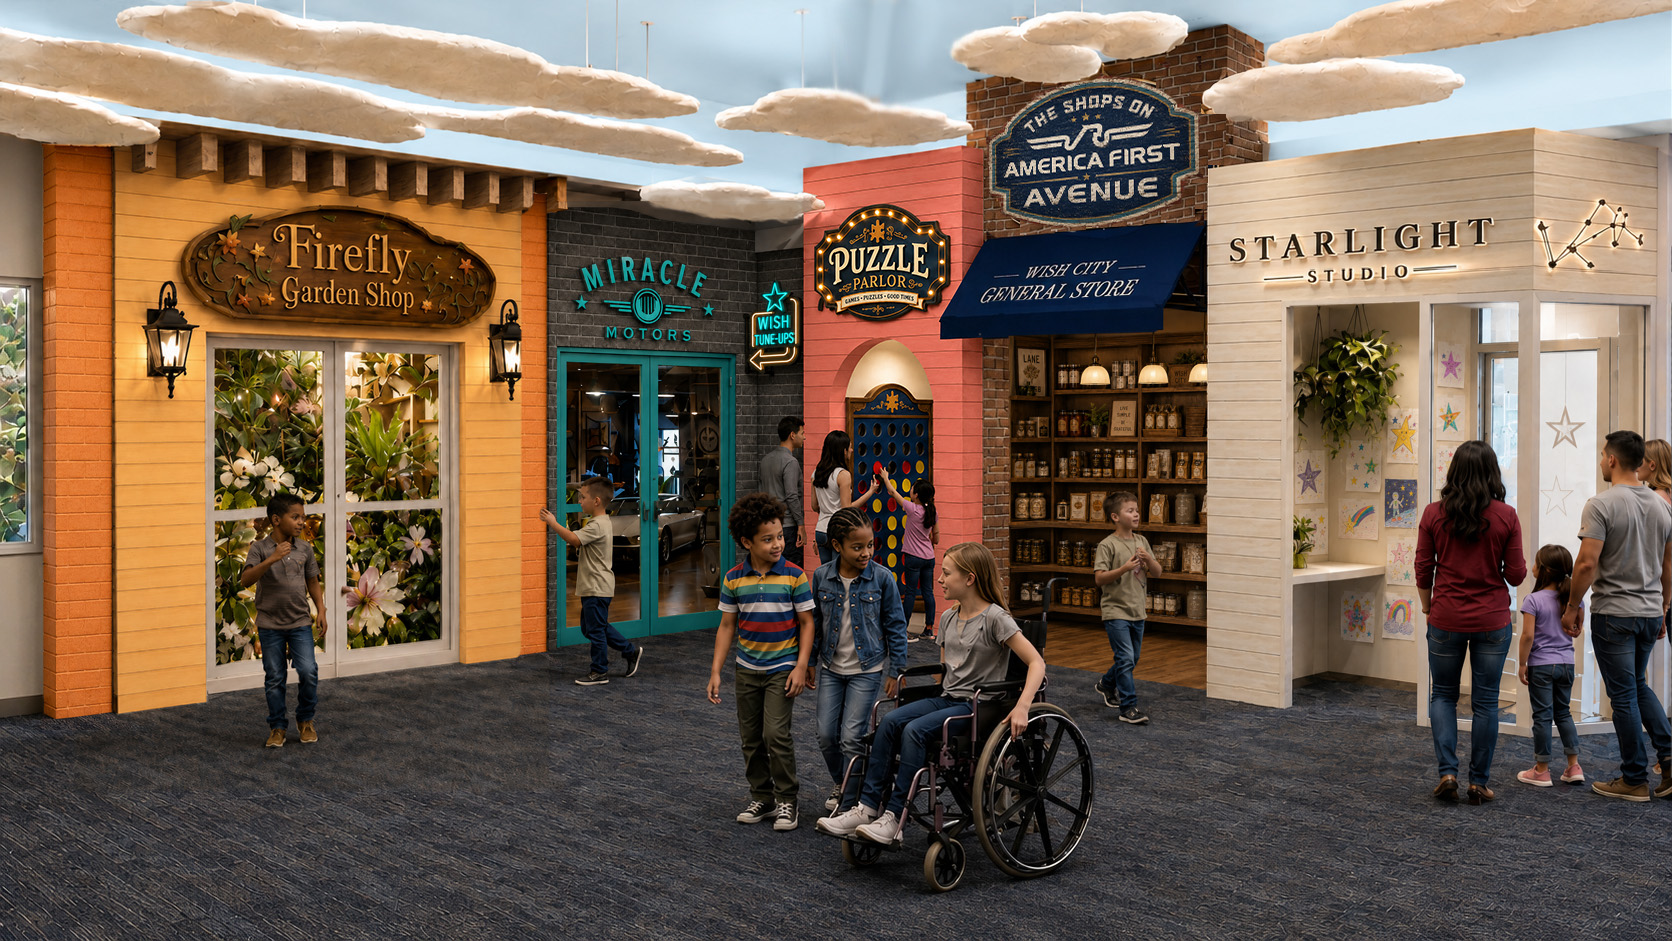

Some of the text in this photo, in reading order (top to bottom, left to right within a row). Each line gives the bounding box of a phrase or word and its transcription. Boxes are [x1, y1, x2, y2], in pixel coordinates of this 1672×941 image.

[1023, 93, 1156, 134] THE SHOPS ON
[1003, 142, 1181, 179] AMERICA FIRST
[1023, 176, 1159, 209] AVENUE
[1229, 217, 1496, 263] STARLIGHT
[273, 223, 412, 285] Firefly
[828, 242, 930, 285] PUZZLE
[581, 256, 707, 299] MIRACLE
[853, 274, 907, 291] PARLOR
[1025, 259, 1118, 280] WISH CITY
[1307, 264, 1409, 284] STUDIO
[281, 275, 415, 315] Garden Shop
[844, 296, 860, 304] GAMES
[863, 293, 884, 301] PUZZLES
[901, 294, 915, 302] TIMES
[980, 278, 1140, 304] GENERAL STORE
[606, 326, 692, 342] MOTORS
[757, 315, 790, 331] WISH
[754, 331, 795, 347] TUNE-UPS
[1023, 354, 1040, 364] LANE
